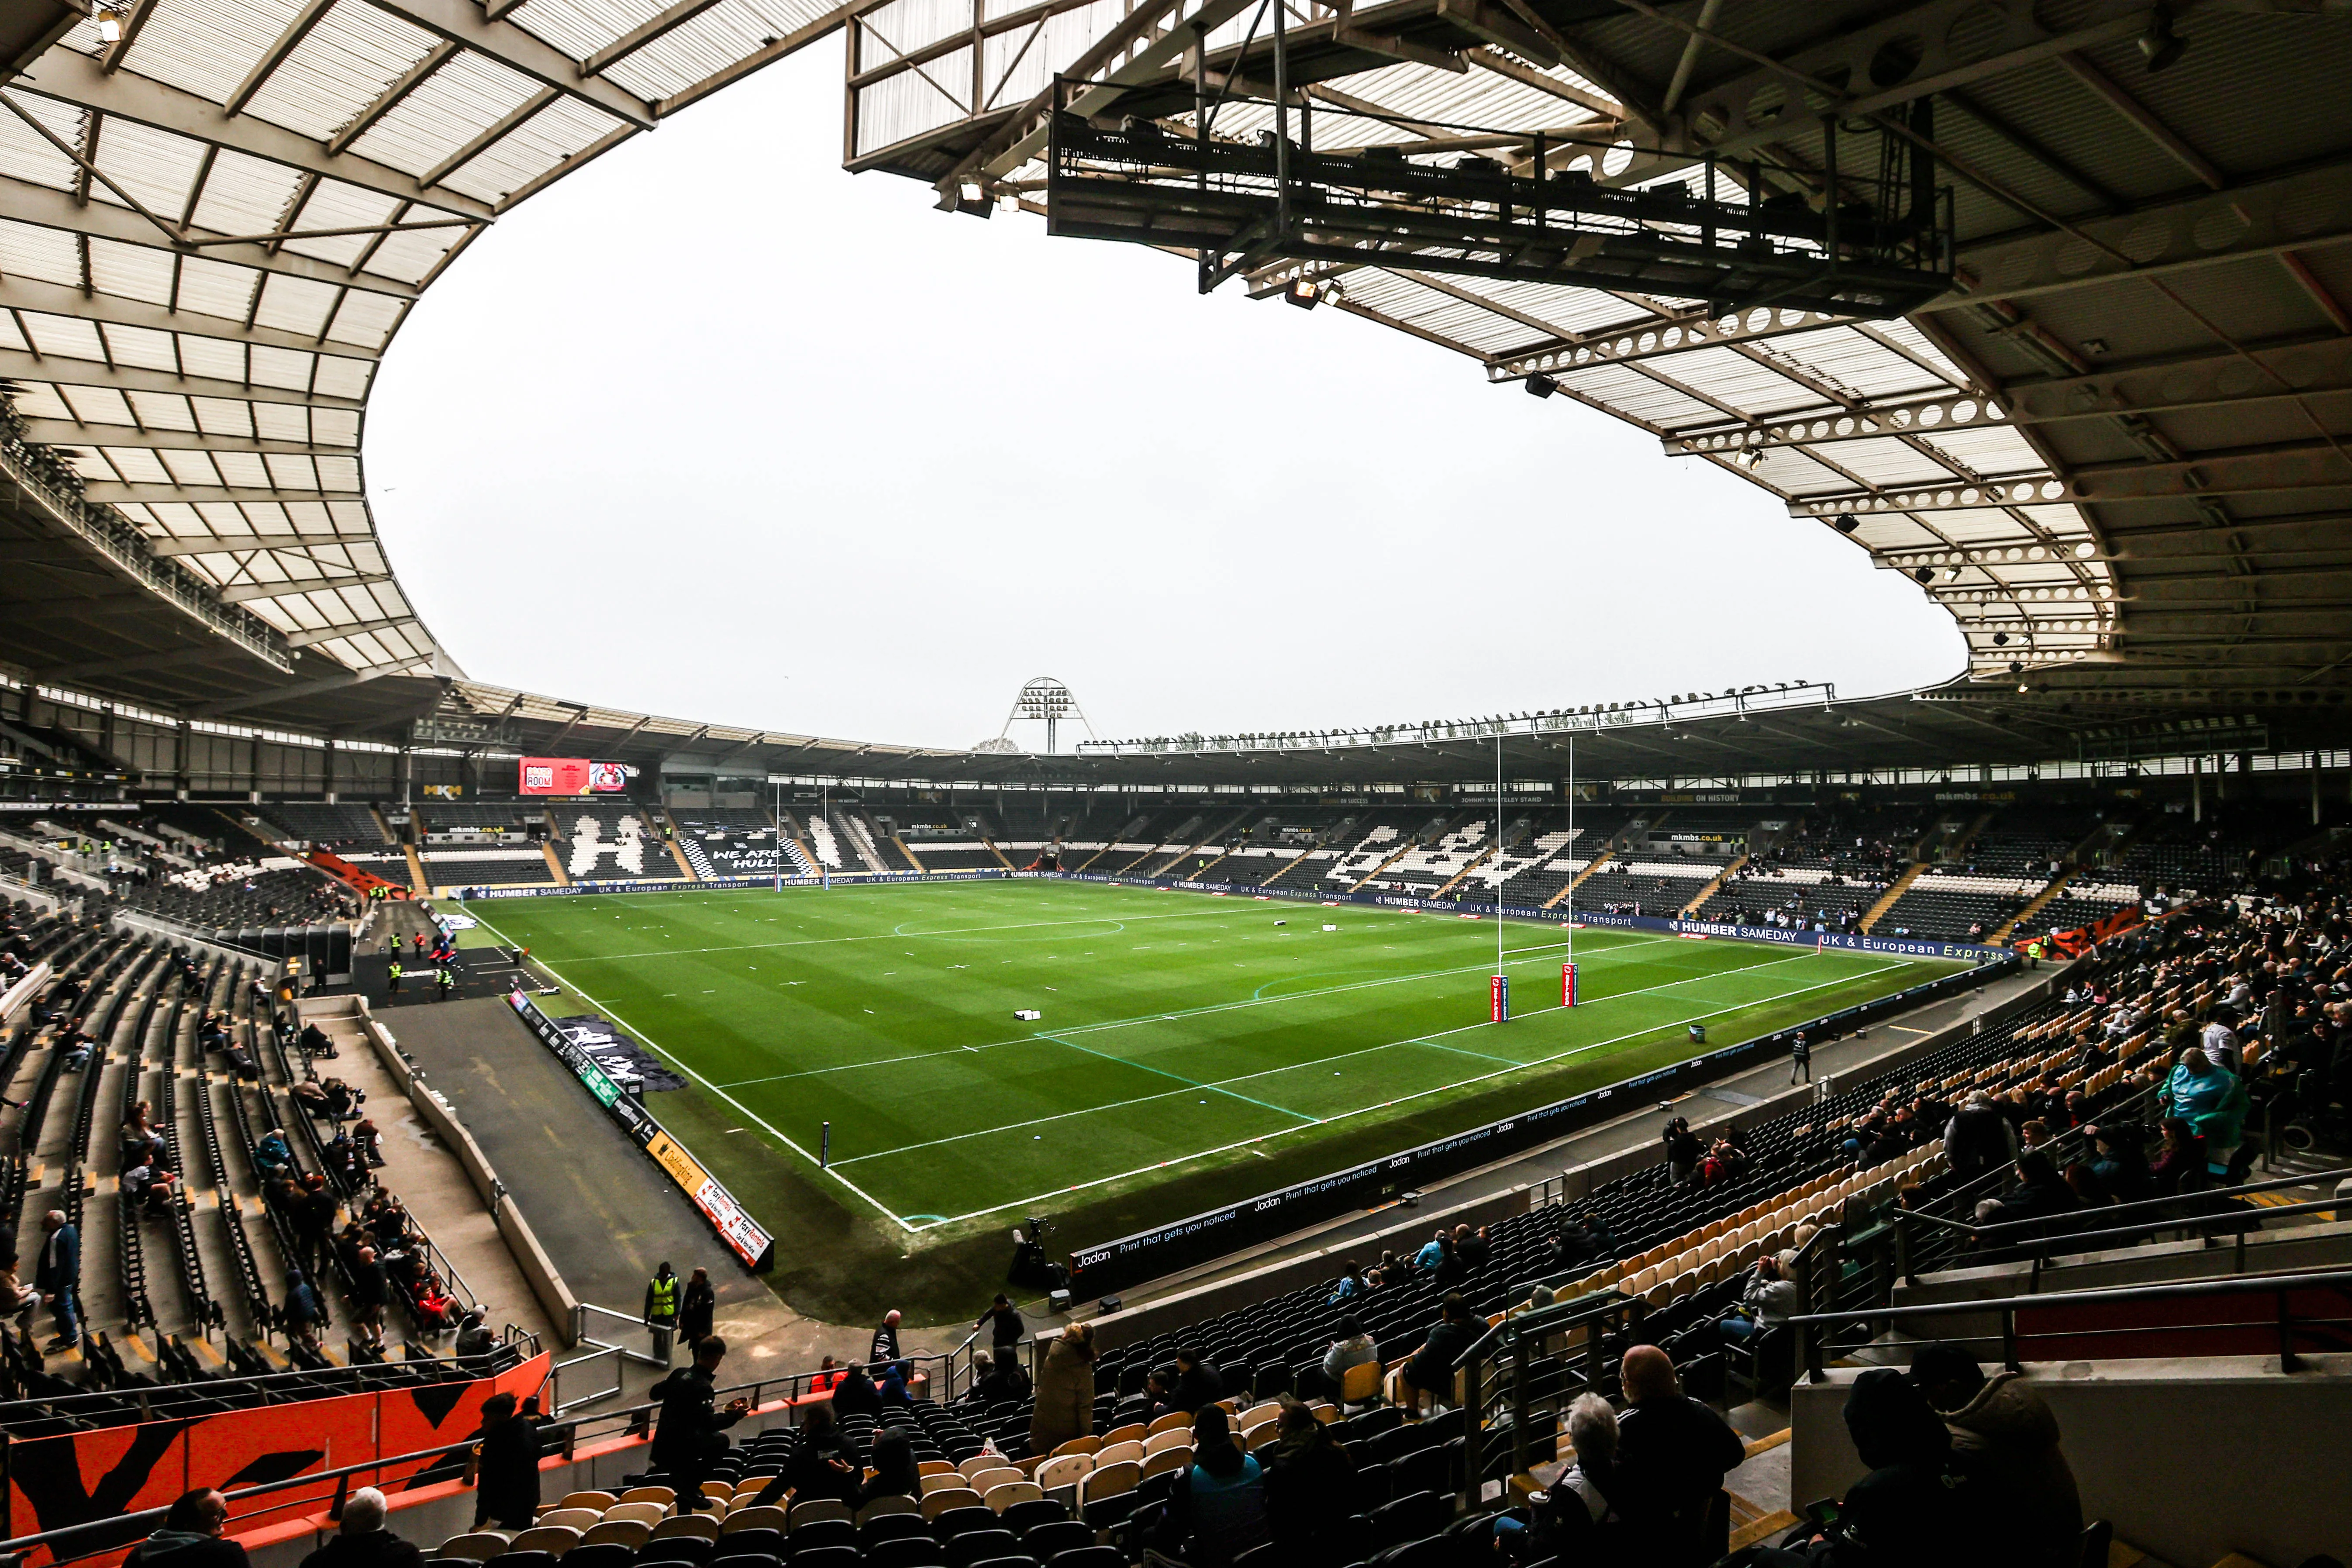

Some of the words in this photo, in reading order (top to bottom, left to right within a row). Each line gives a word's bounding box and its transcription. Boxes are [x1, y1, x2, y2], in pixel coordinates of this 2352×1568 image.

[528, 776, 552, 786] ROOM
[424, 785, 462, 800] MKM
[1935, 792, 2016, 801] mkmbs.co.uk
[713, 851, 742, 860] WE
[745, 849, 783, 858] ARE
[731, 858, 777, 868] HULL
[490, 889, 537, 898] HUMBER
[540, 887, 583, 896] SAMEDAY
[672, 883, 706, 892] Express
[1179, 881, 1205, 890] HUMBER
[1206, 882, 1231, 892] SAMEDAY
[1258, 887, 1288, 896] European
[1290, 889, 1317, 898] Express
[1319, 892, 1352, 901] Transport
[1384, 896, 1419, 907] HUMBER
[1421, 899, 1456, 910] SAMEDAY
[1470, 904, 1481, 913] UK
[1495, 906, 1537, 917] European
[1541, 910, 1579, 921] Expres
[1583, 913, 1631, 926] Transport
[1682, 922, 1737, 936] HUMBER
[1741, 927, 1798, 943] SAMEDAY
[1821, 934, 1839, 946] UK
[1847, 937, 1855, 948] &
[1862, 938, 1935, 955] European
[1691, 1059, 1702, 1068] Jadan
[1597, 1089, 1612, 1099] Jadan
[1528, 1114, 1538, 1122] Print
[1550, 1106, 1559, 1116] gets
[1561, 1103, 1569, 1113] you
[1570, 1098, 1586, 1109] noticed
[1497, 1122, 1514, 1134] Jadan
[1418, 1149, 1431, 1158] Print
[1432, 1145, 1444, 1154] that
[1445, 1141, 1457, 1151] gets
[1459, 1137, 1469, 1147] you
[1470, 1129, 1490, 1141] noticed
[1389, 1156, 1410, 1168] Jadan
[1286, 1189, 1302, 1201] Print
[1304, 1184, 1319, 1195] that
[1321, 1180, 1336, 1192] gets
[1338, 1175, 1351, 1187] you
[1352, 1165, 1377, 1180] noticed
[1255, 1197, 1280, 1212] Jadan
[739, 1220, 765, 1248] FoxyRentals
[1120, 1240, 1140, 1253] Print
[1143, 1233, 1161, 1246] that
[1164, 1227, 1183, 1241] gets
[1185, 1222, 1201, 1235] you
[1204, 1210, 1235, 1227] noticed
[1078, 1250, 1110, 1268] Jadan
